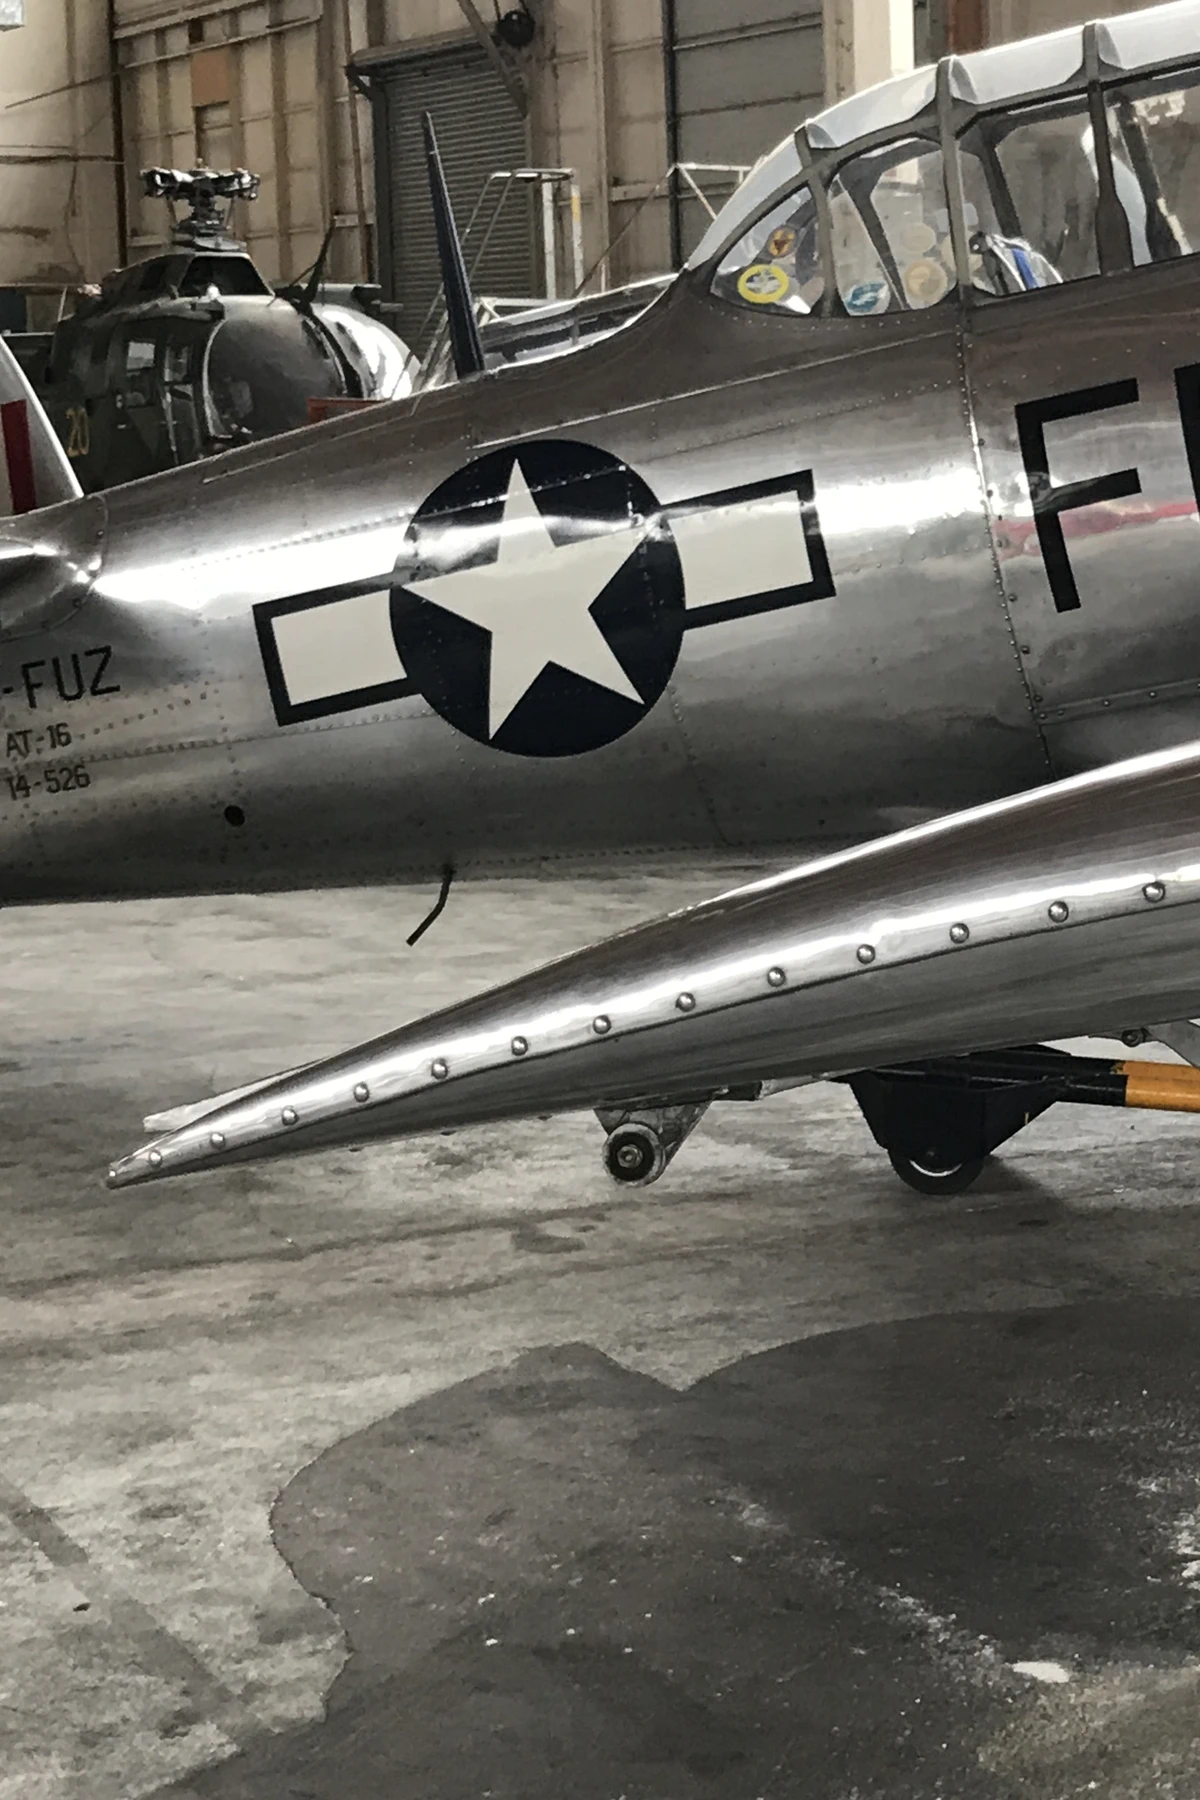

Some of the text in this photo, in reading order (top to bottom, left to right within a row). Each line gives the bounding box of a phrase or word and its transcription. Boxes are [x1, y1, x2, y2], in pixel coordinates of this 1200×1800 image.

[64, 407, 90, 457] 20
[6, 722, 72, 758] AT-16
[6, 764, 91, 800] 14-526
